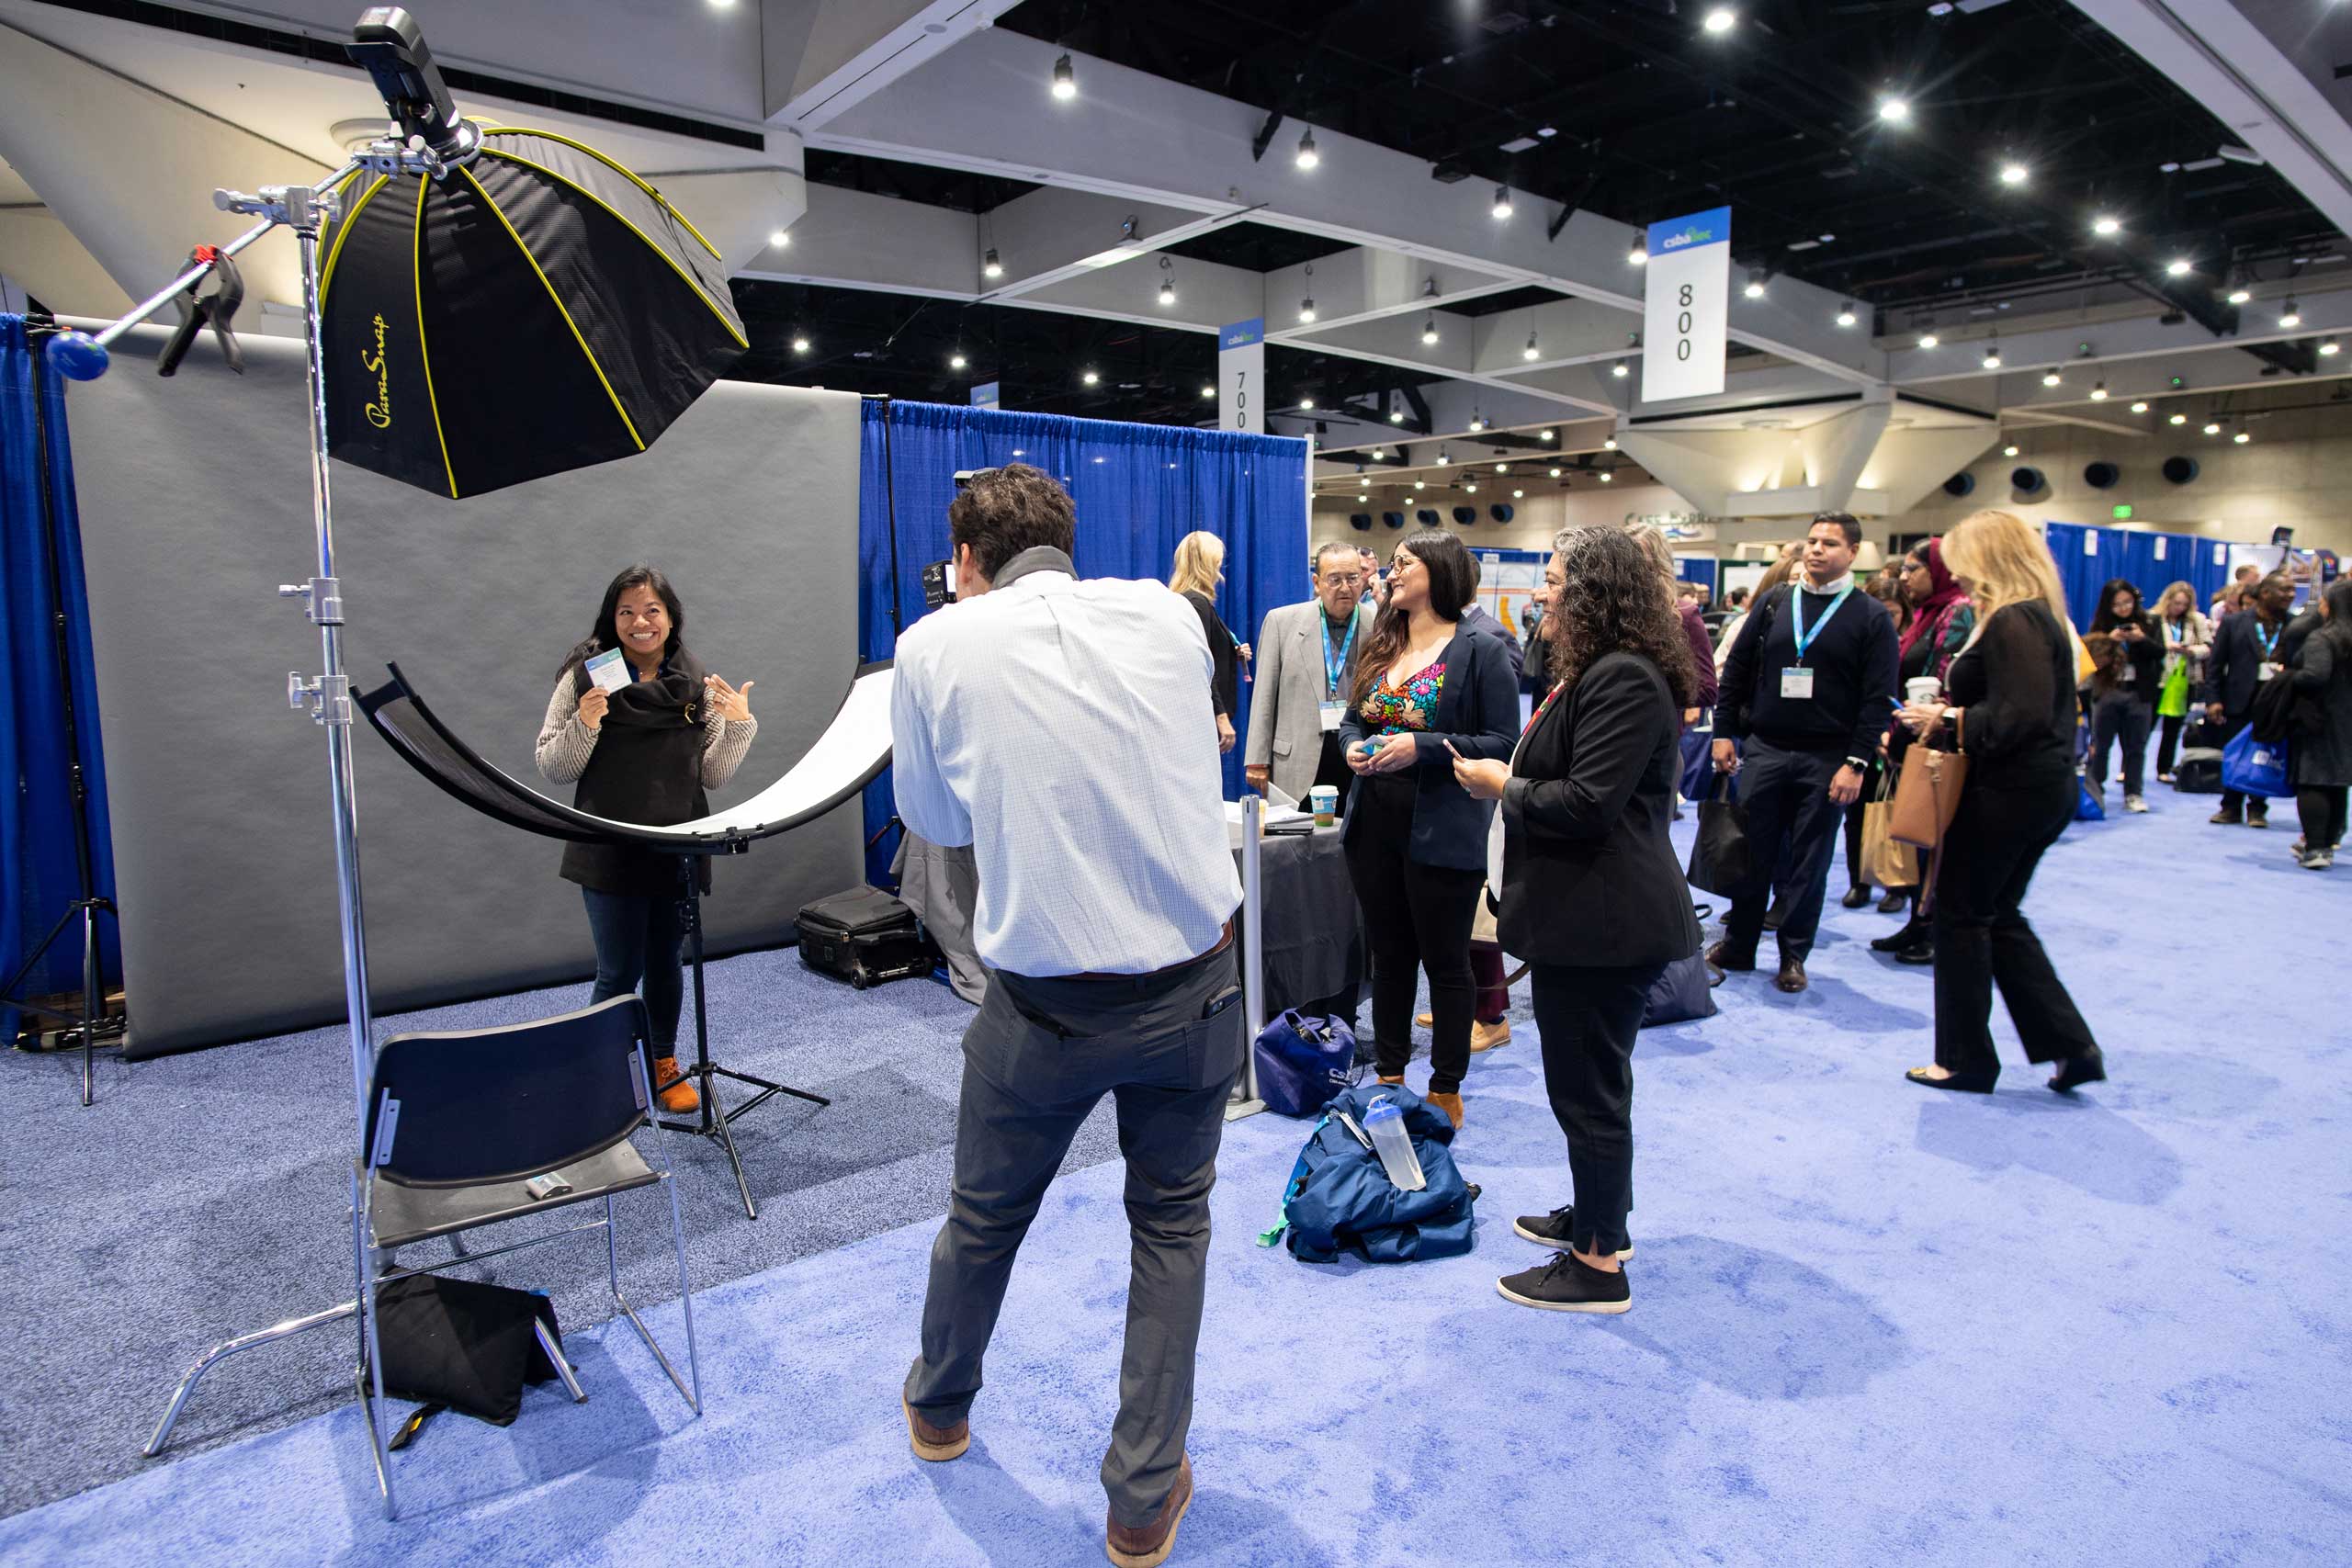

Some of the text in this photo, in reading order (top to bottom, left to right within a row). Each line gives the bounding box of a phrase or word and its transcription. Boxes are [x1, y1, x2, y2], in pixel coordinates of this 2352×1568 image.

[1676, 284, 1693, 361] 800
[361, 312, 391, 429] ParaSnap
[1237, 371, 1246, 429] 700
